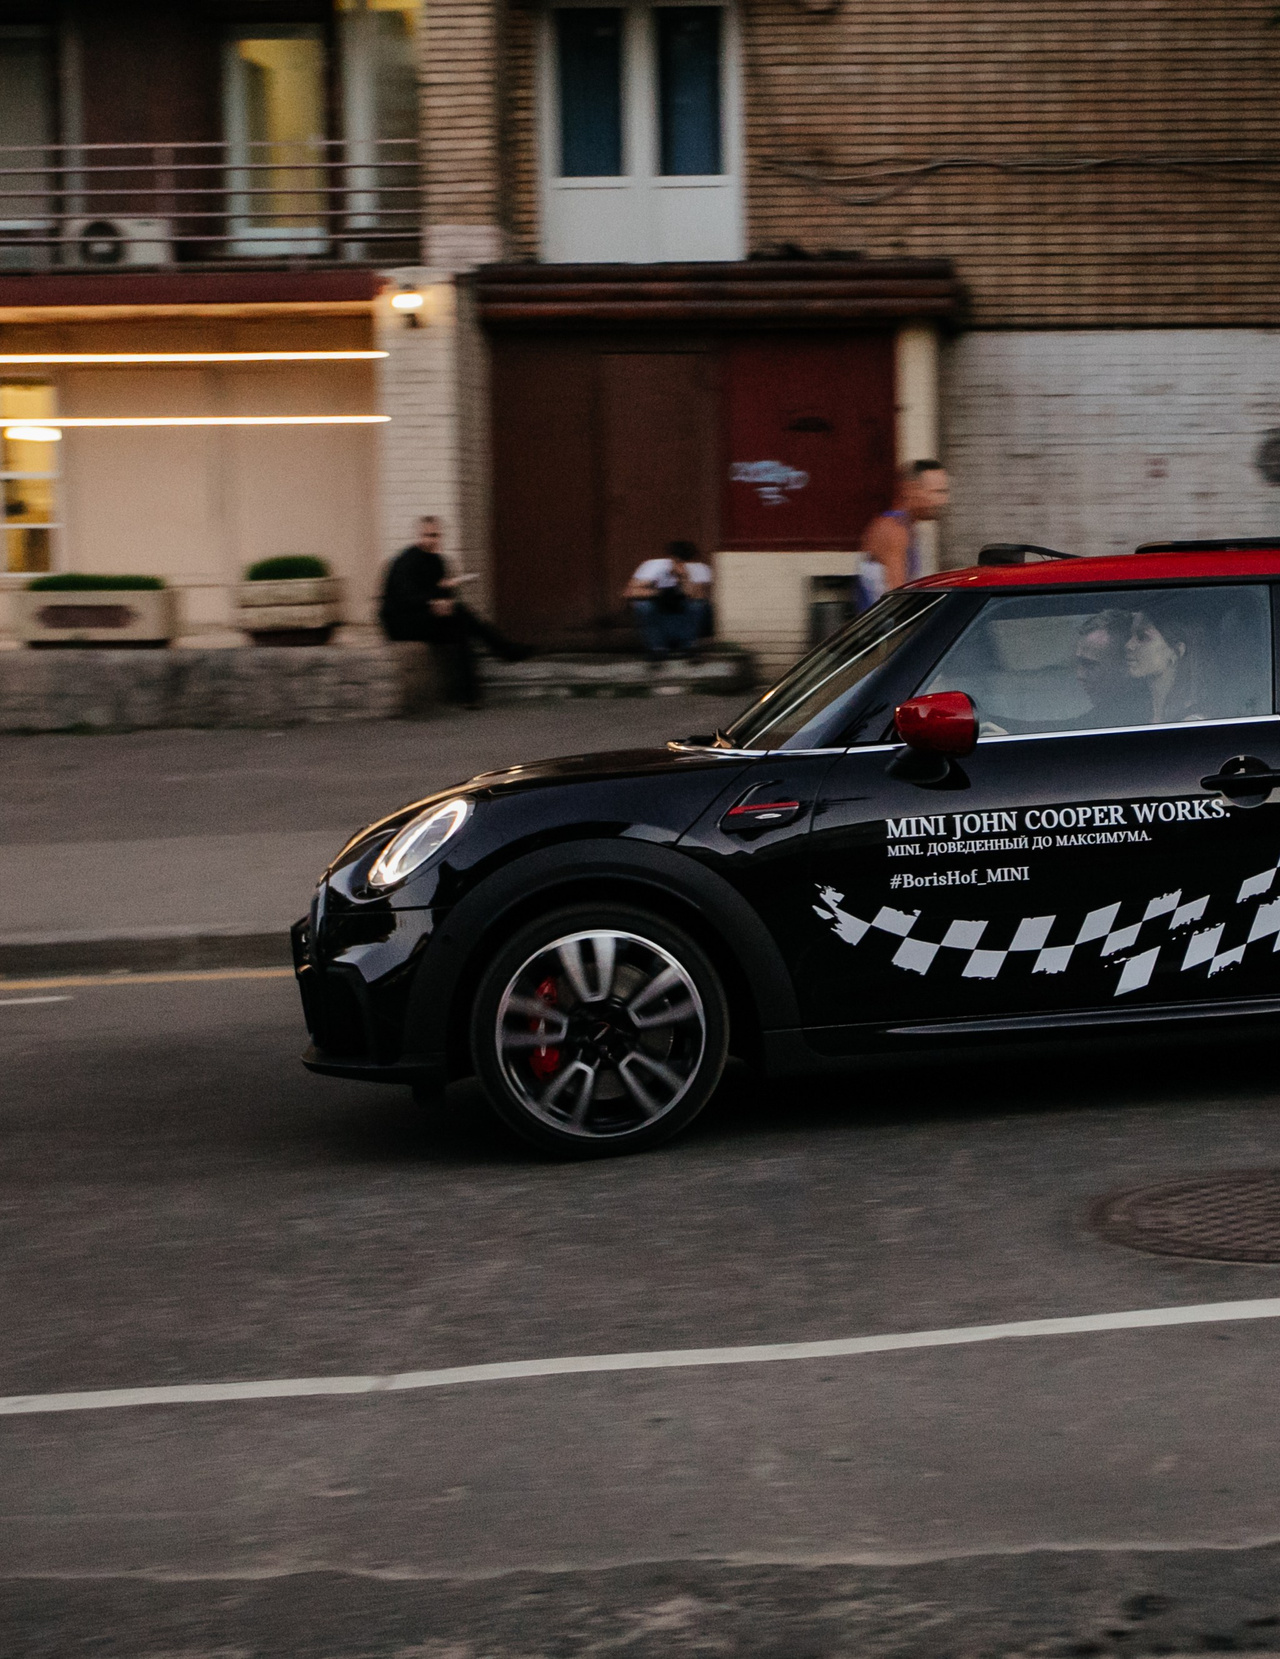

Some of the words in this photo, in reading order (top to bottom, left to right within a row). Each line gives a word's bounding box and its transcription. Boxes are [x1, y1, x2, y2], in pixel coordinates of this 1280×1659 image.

[885, 815, 947, 839] MINI
[953, 811, 1018, 840] JOHN
[1024, 805, 1127, 830] COOPER
[1131, 799, 1231, 823] WORKS.
[887, 844, 924, 857] MINI.
[926, 835, 1029, 856] ДОВЕДЕННЫЙ
[1032, 836, 1053, 851] ДО
[1055, 830, 1153, 847] МАКСИМУМА.
[889, 866, 1030, 889] #BorisHof_MINI
